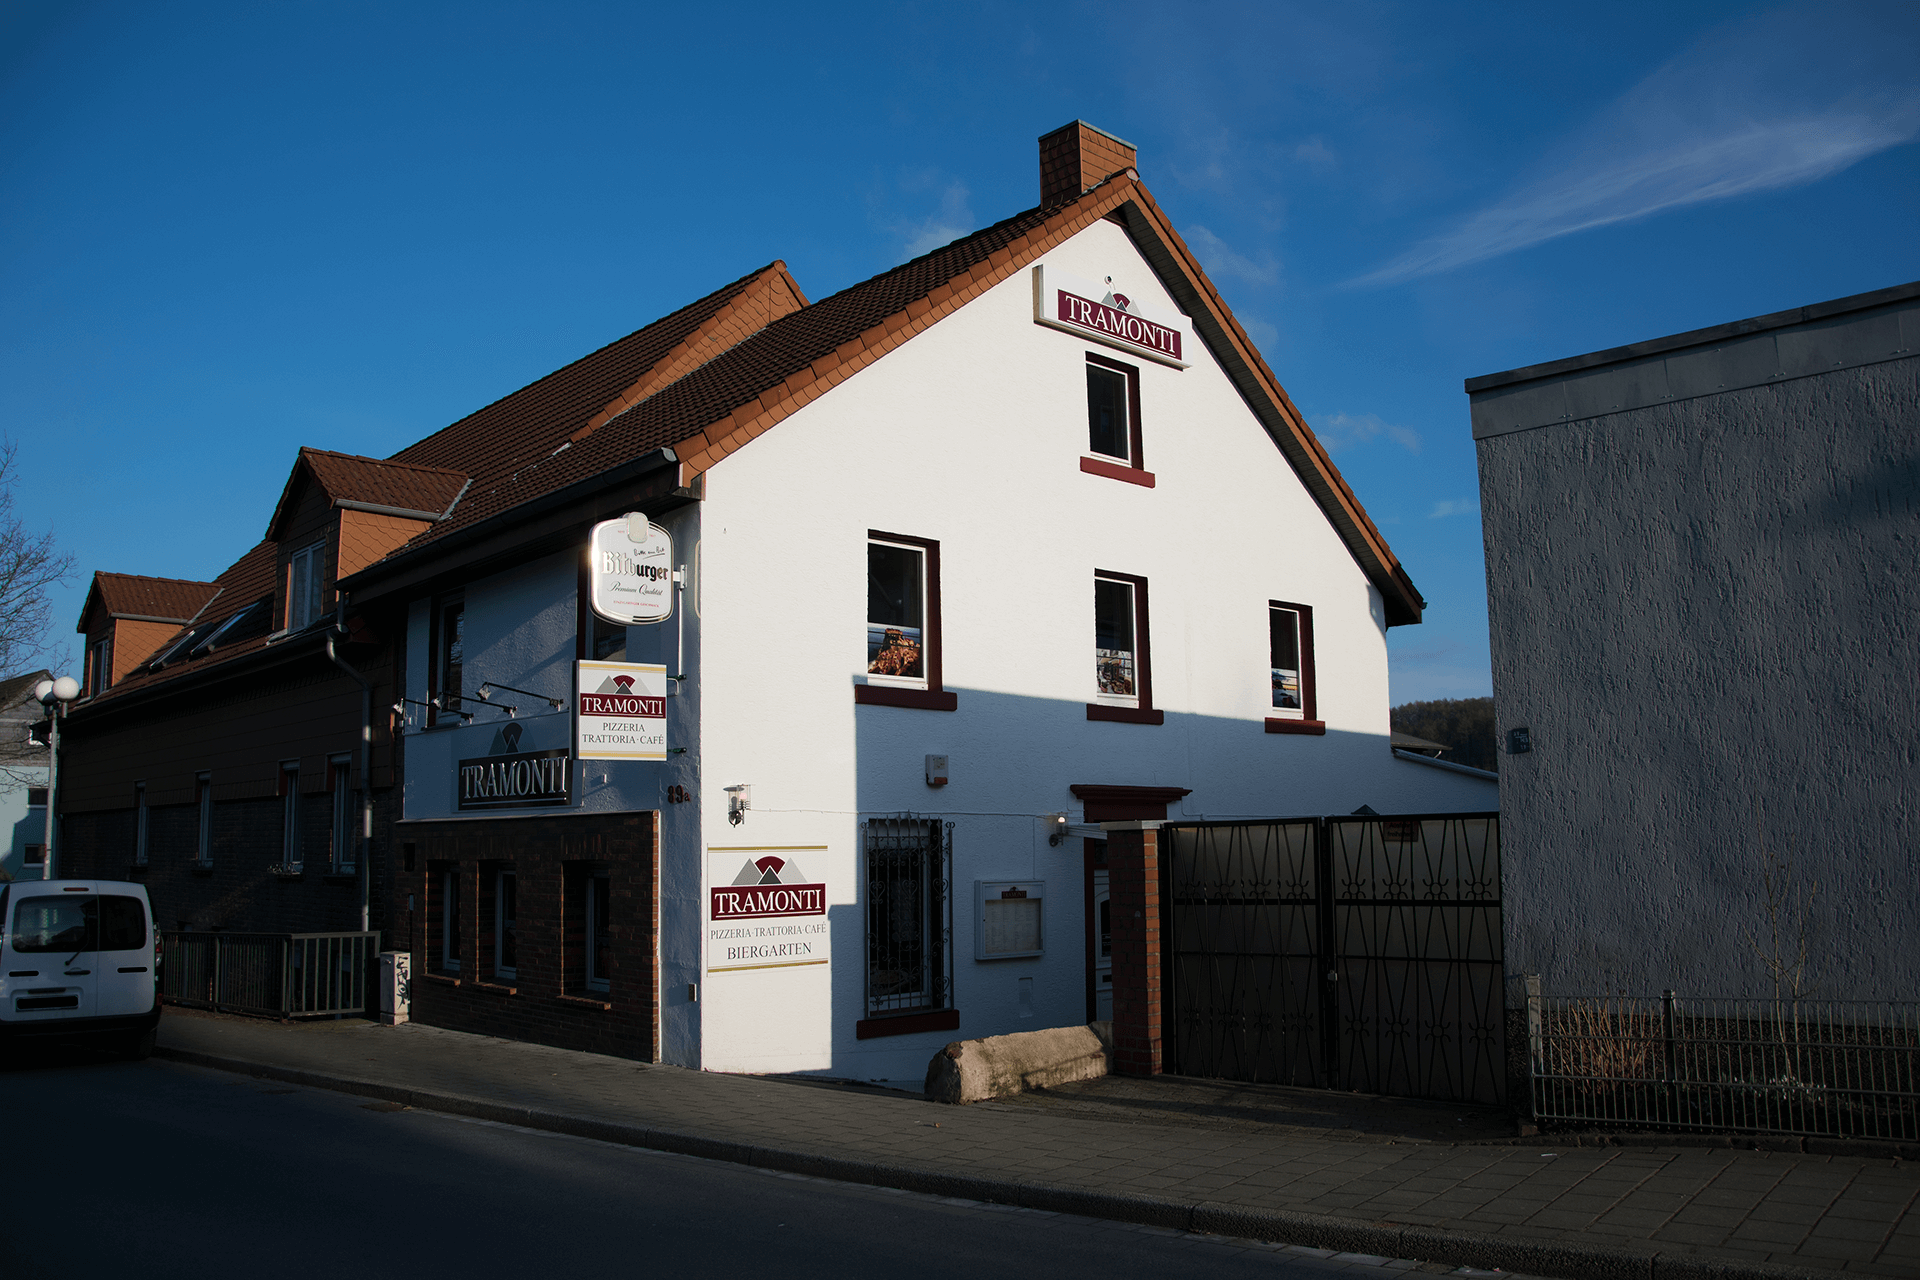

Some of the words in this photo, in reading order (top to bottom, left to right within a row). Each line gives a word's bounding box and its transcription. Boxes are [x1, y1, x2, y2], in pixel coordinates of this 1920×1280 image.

[1065, 295, 1175, 354] TRAMONTI
[601, 551, 669, 582] Bitburger
[583, 697, 663, 714] TRAMONTI
[602, 722, 645, 732] PIZZERIA
[461, 756, 568, 799] TRAMONTI
[667, 785, 691, 803] 89a
[714, 889, 822, 914] TRAMONTI
[727, 942, 812, 960] BIERGARTEN
